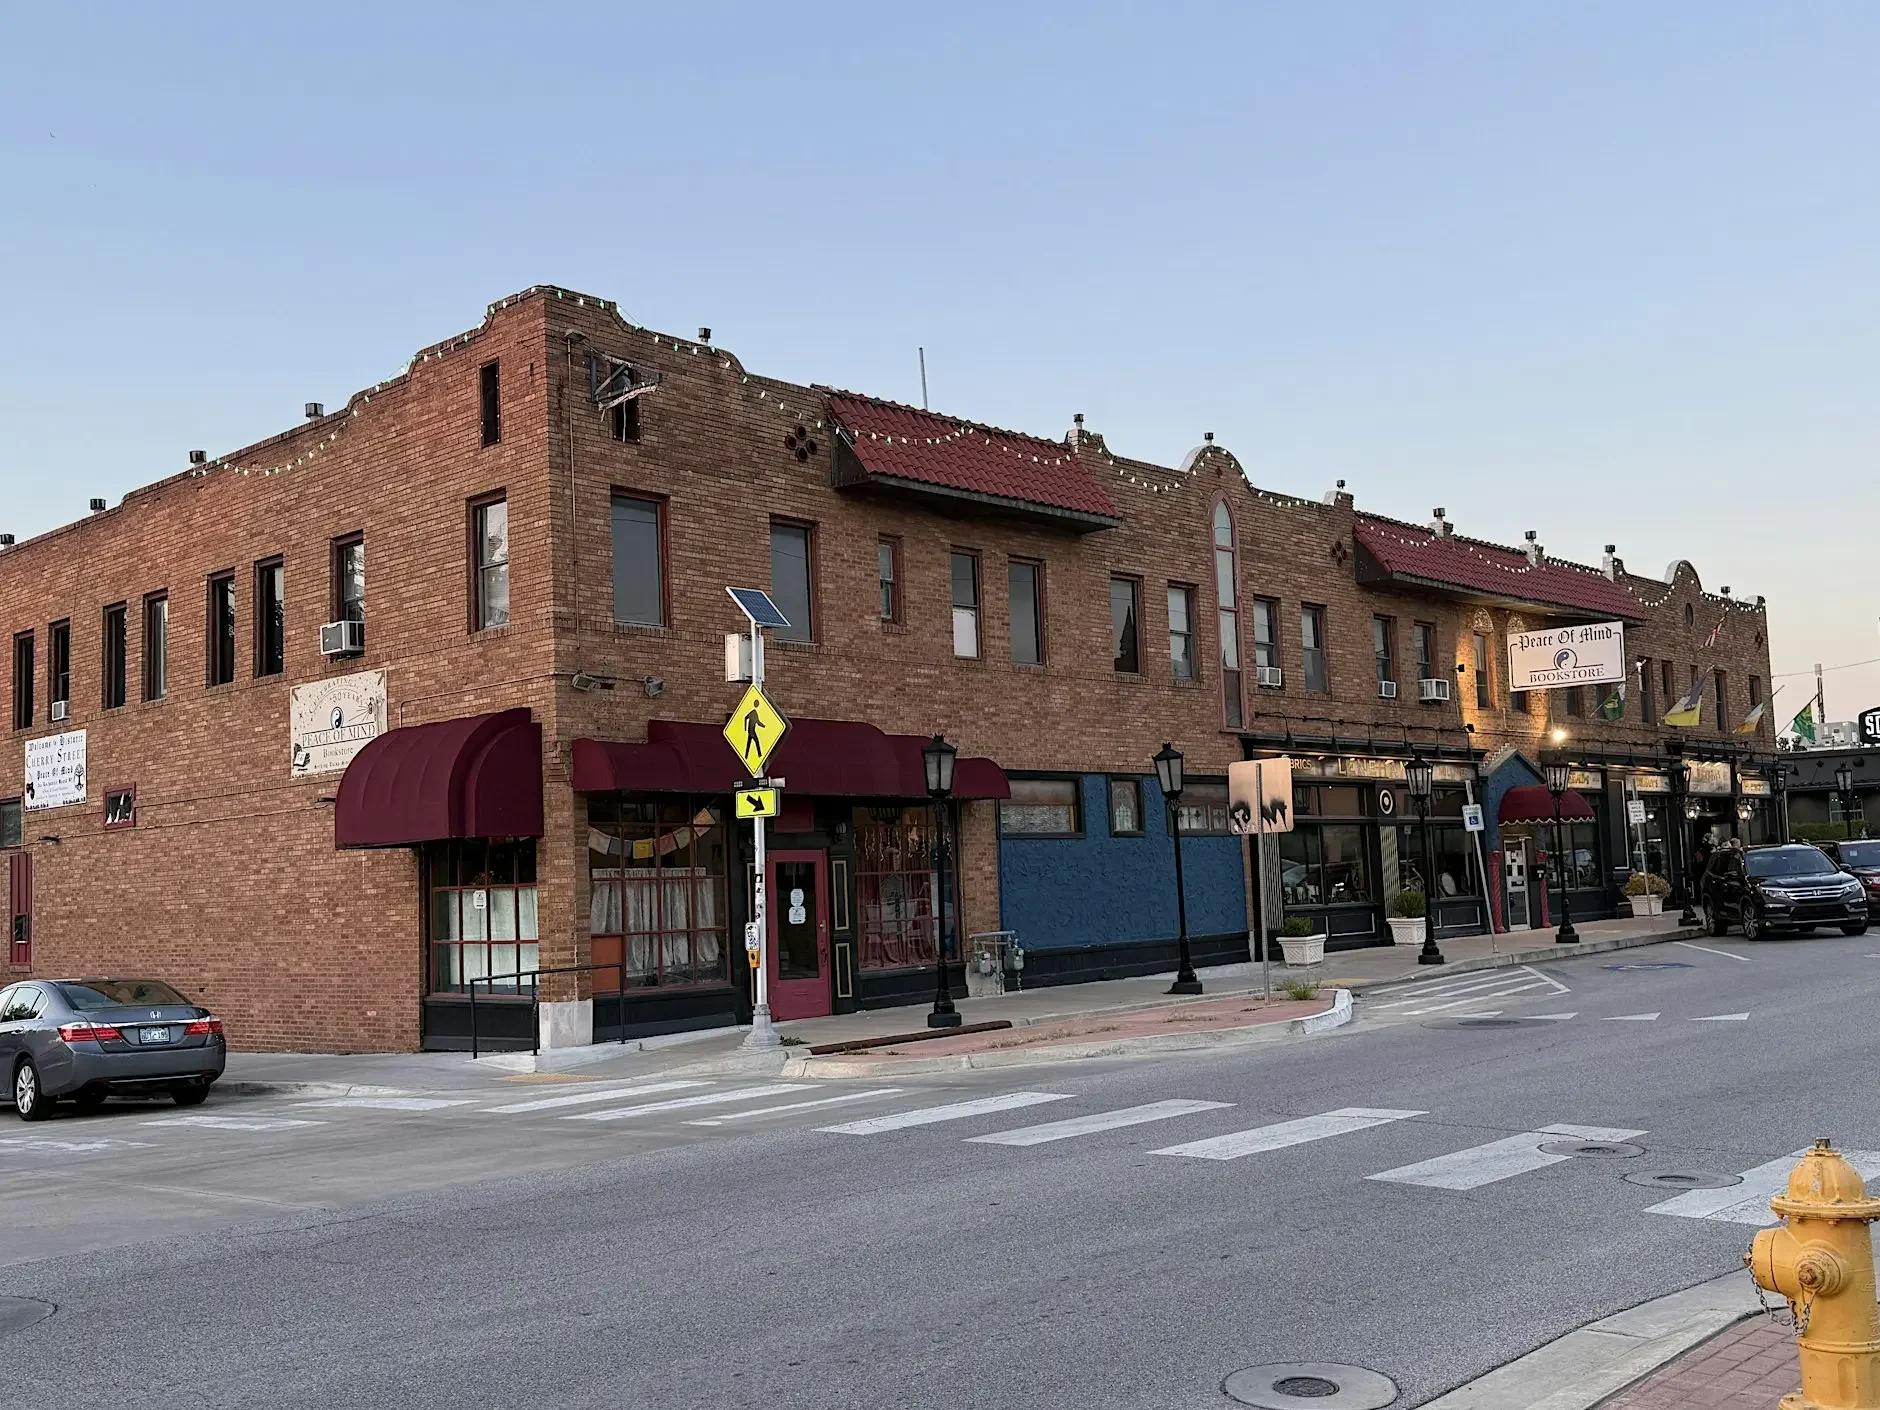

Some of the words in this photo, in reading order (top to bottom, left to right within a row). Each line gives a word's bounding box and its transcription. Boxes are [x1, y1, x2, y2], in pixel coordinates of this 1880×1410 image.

[1518, 635, 1553, 651] Peace
[1558, 629, 1575, 644] Of
[1579, 625, 1612, 643] Mind
[1530, 667, 1605, 683] BOOKSTORE
[332, 692, 342, 703] 50
[302, 732, 331, 747] PEACE
[333, 729, 346, 743] OF
[348, 724, 375, 739] MIND
[29, 741, 51, 751] Welcome
[323, 747, 353, 758] Bookstore
[26, 754, 54, 768] CHERRY
[57, 748, 85, 763] STREET
